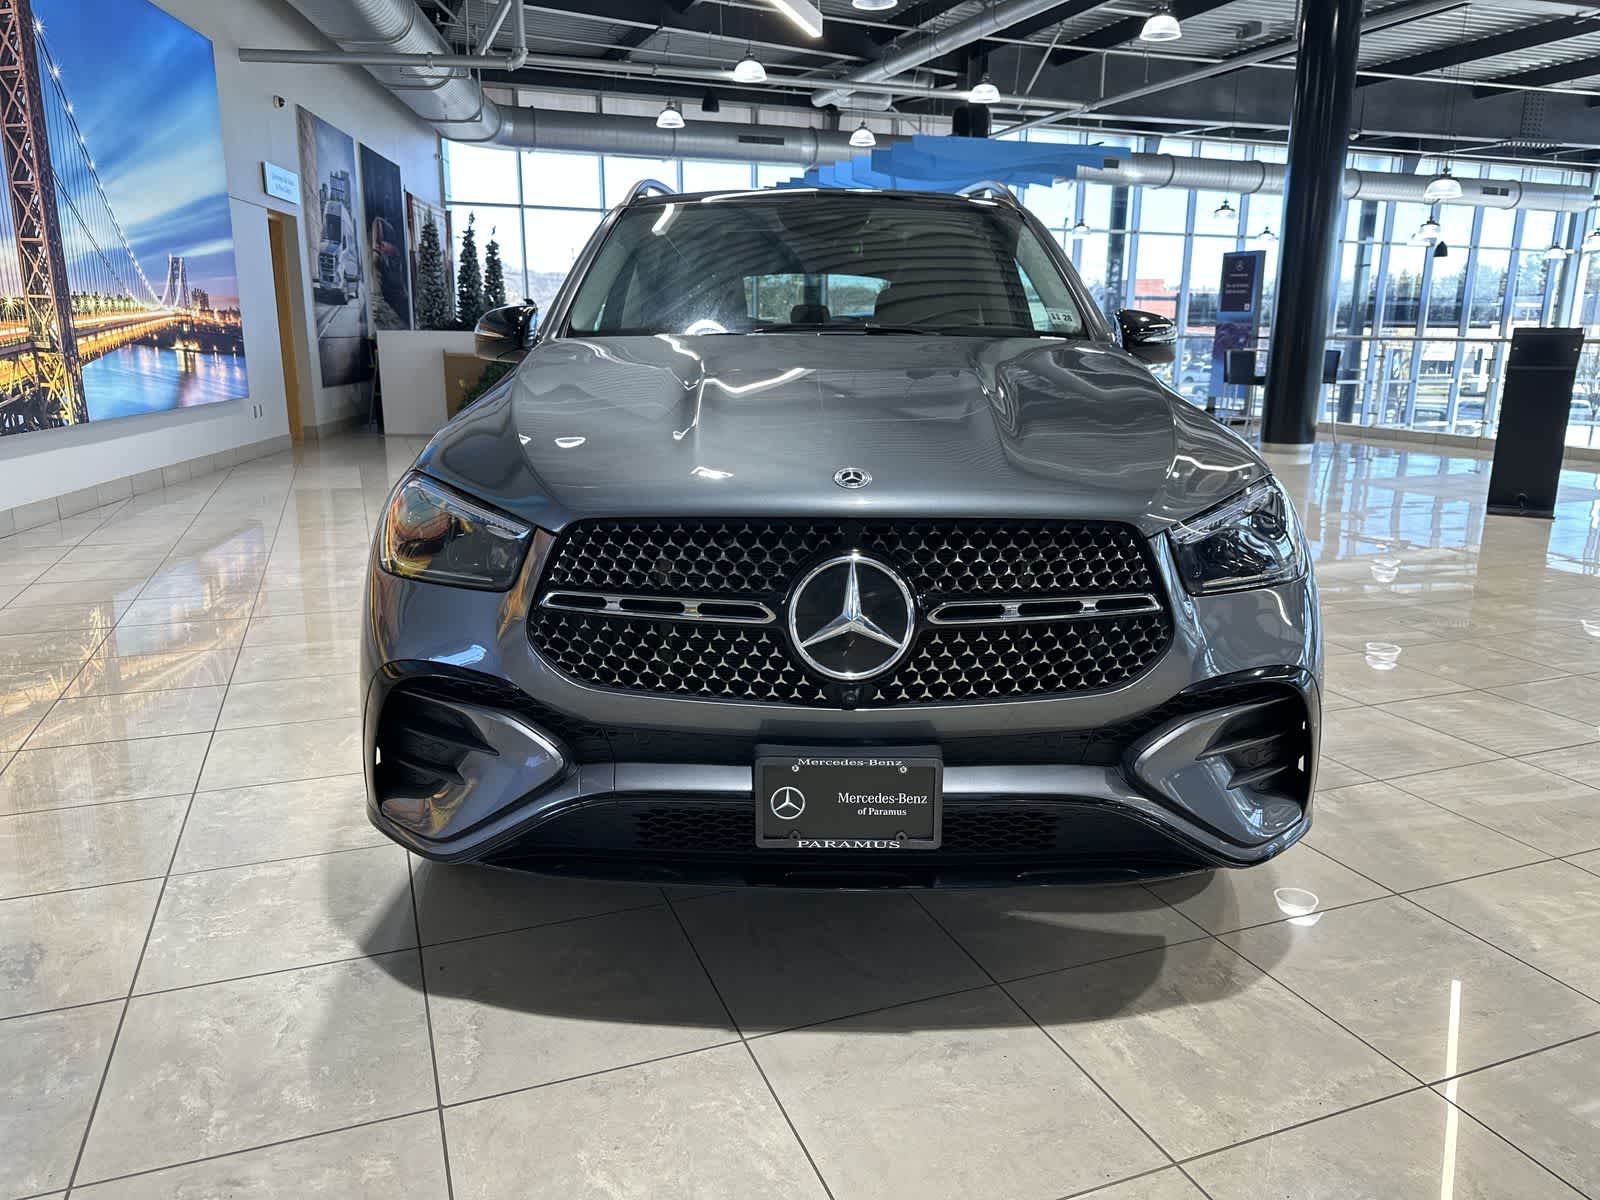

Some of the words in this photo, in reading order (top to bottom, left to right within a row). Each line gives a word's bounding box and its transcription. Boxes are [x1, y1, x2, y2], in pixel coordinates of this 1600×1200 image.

[797, 758, 903, 767] Mercedes-Benz
[837, 792, 928, 805] Mercedes-Benz
[857, 807, 867, 816] of
[868, 808, 907, 816] Paramus
[796, 840, 901, 849] PARAMUS
